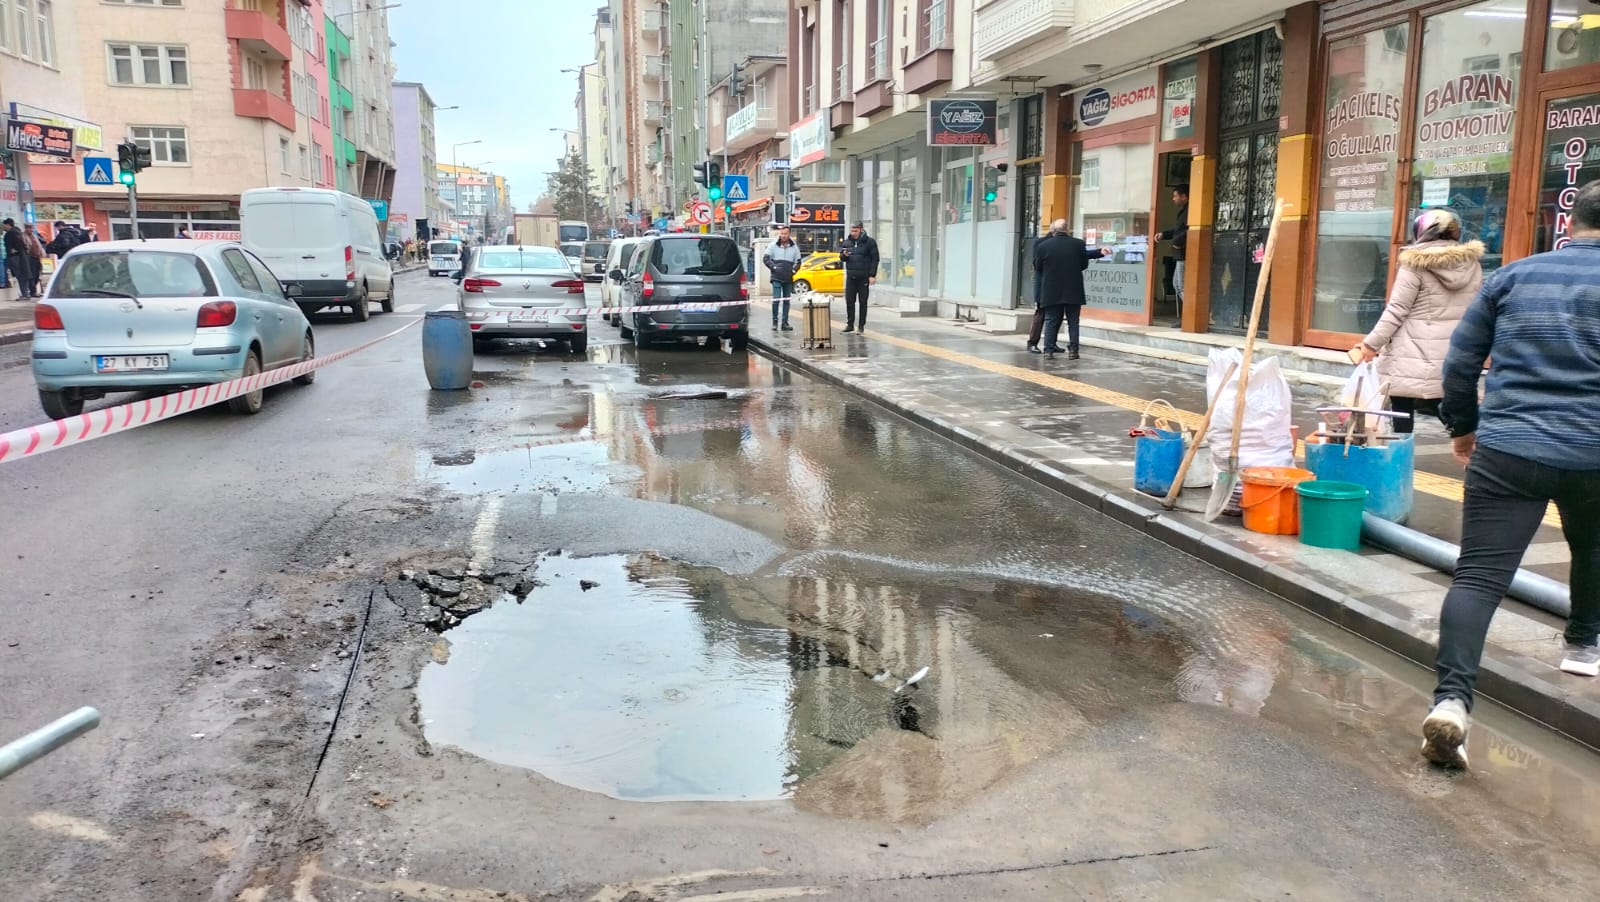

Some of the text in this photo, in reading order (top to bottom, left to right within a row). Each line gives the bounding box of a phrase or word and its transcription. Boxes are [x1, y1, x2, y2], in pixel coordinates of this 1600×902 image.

[1082, 85, 1156, 117] YAĞIZ SİGORTA
[1423, 72, 1513, 118] BARAN
[942, 109, 982, 123] YAĞIZ
[1419, 108, 1513, 143] OTOMOTİV
[9, 125, 45, 151] MAKAS
[935, 131, 989, 145] SİGORTA
[815, 210, 839, 221] EGE
[194, 232, 214, 240] KARS
[103, 356, 166, 368] 27 KY 761
